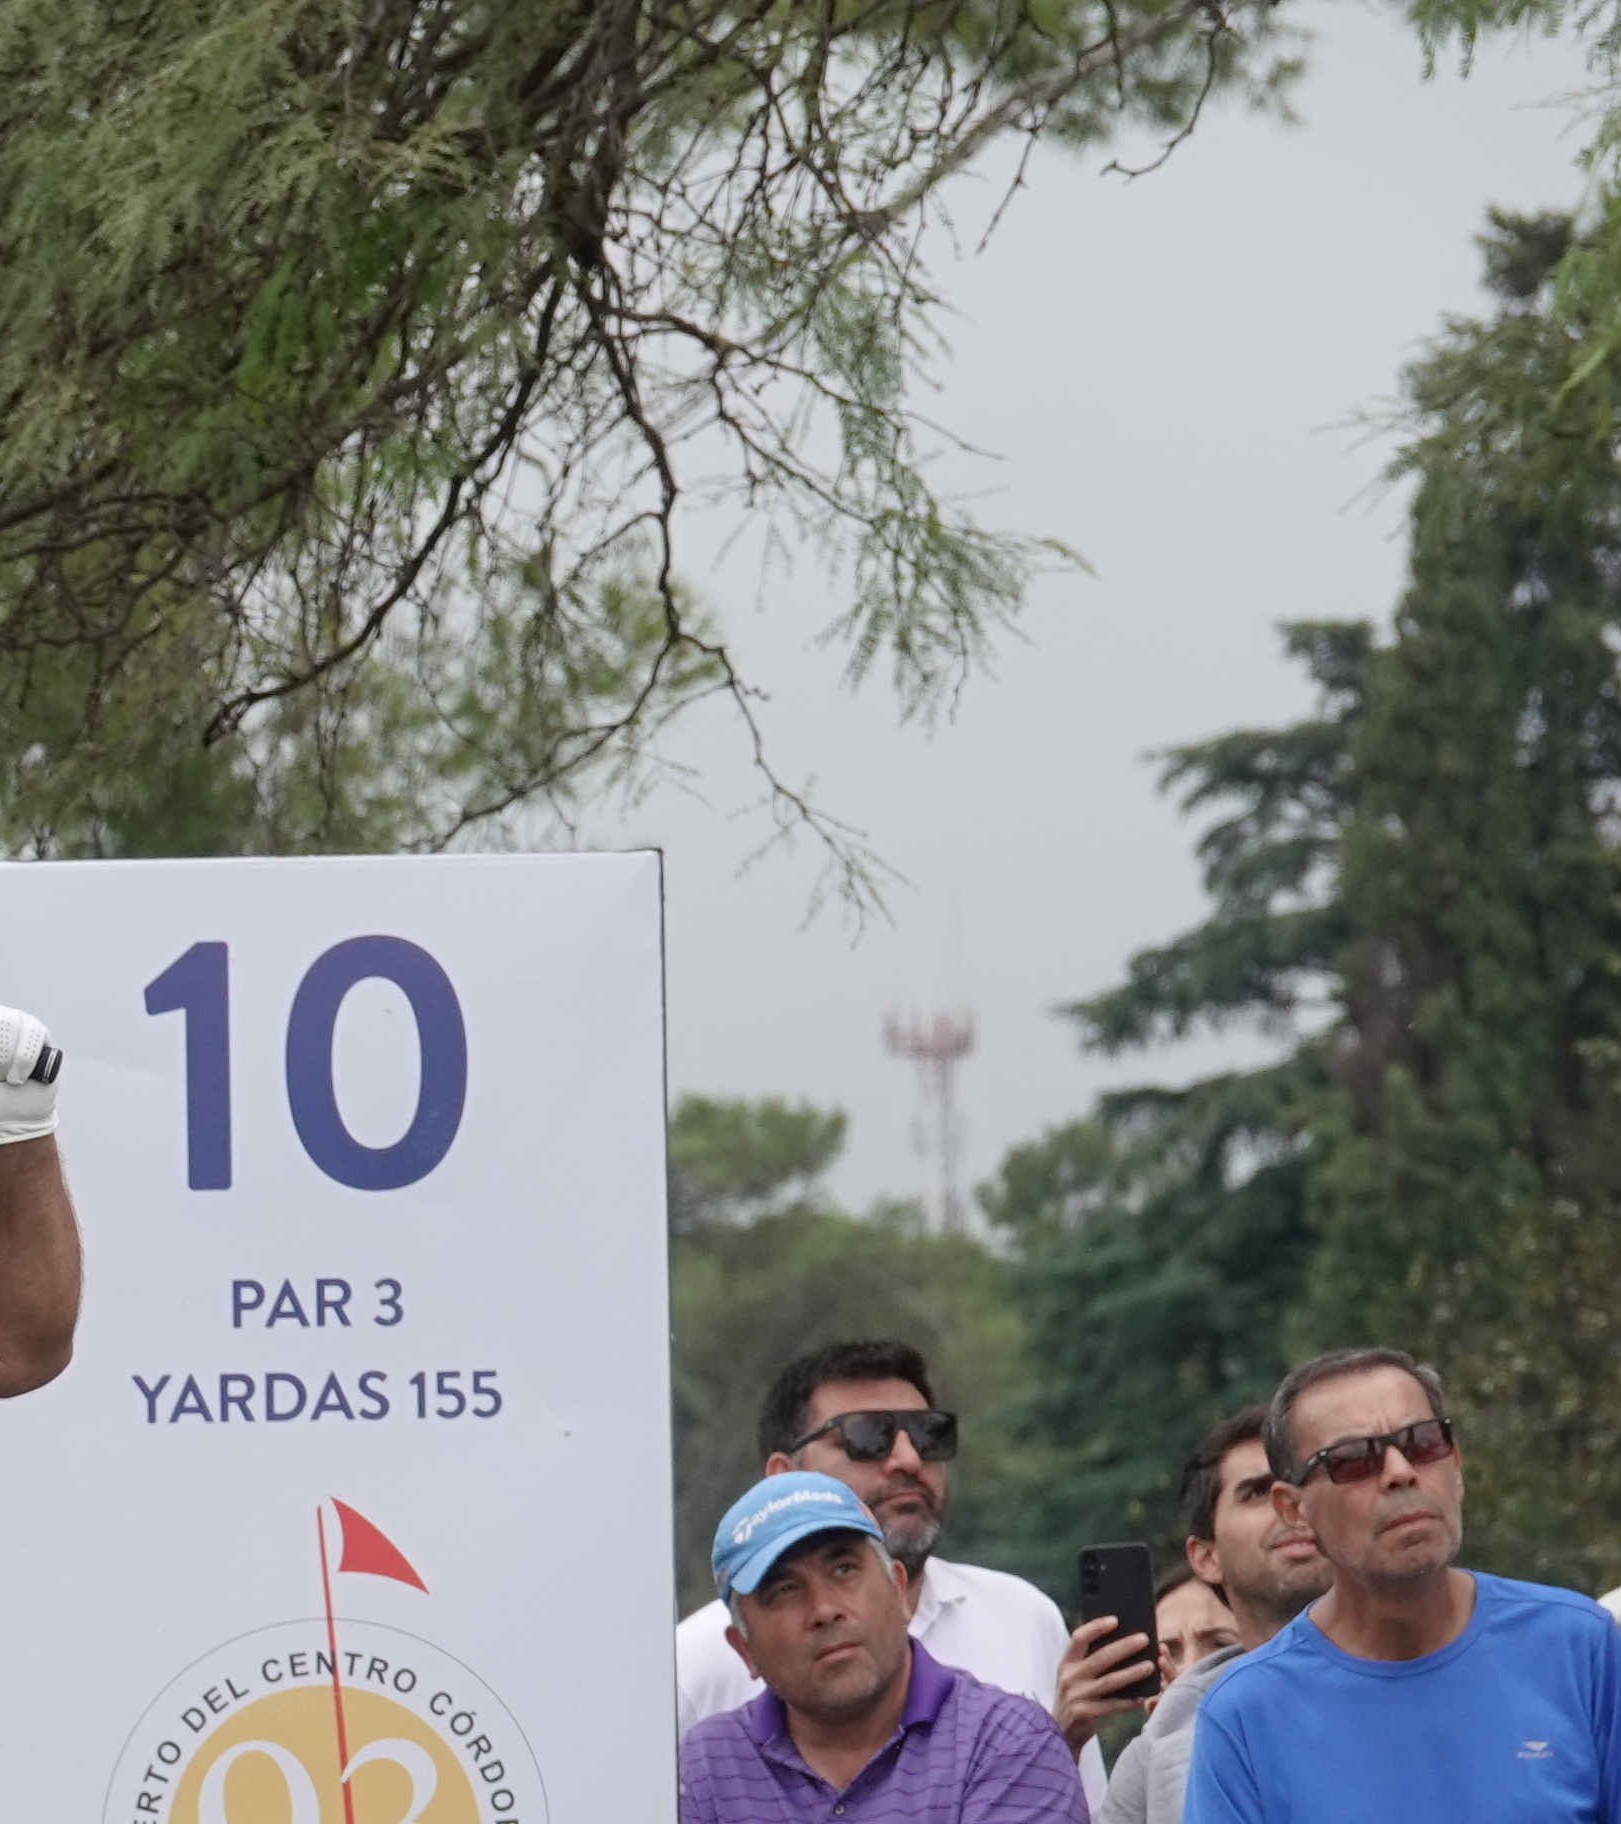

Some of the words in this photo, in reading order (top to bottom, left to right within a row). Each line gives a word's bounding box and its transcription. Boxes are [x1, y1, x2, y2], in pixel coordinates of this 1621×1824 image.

[143, 934, 468, 1192] 10
[231, 1279, 352, 1328] PAR
[374, 1278, 405, 1326] 3
[132, 1371, 390, 1424] YARDAS
[409, 1369, 504, 1420] 155
[732, 1489, 843, 1544] TaylorMade
[180, 1677, 249, 1734] DEL
[261, 1649, 418, 1694] CENTRO
